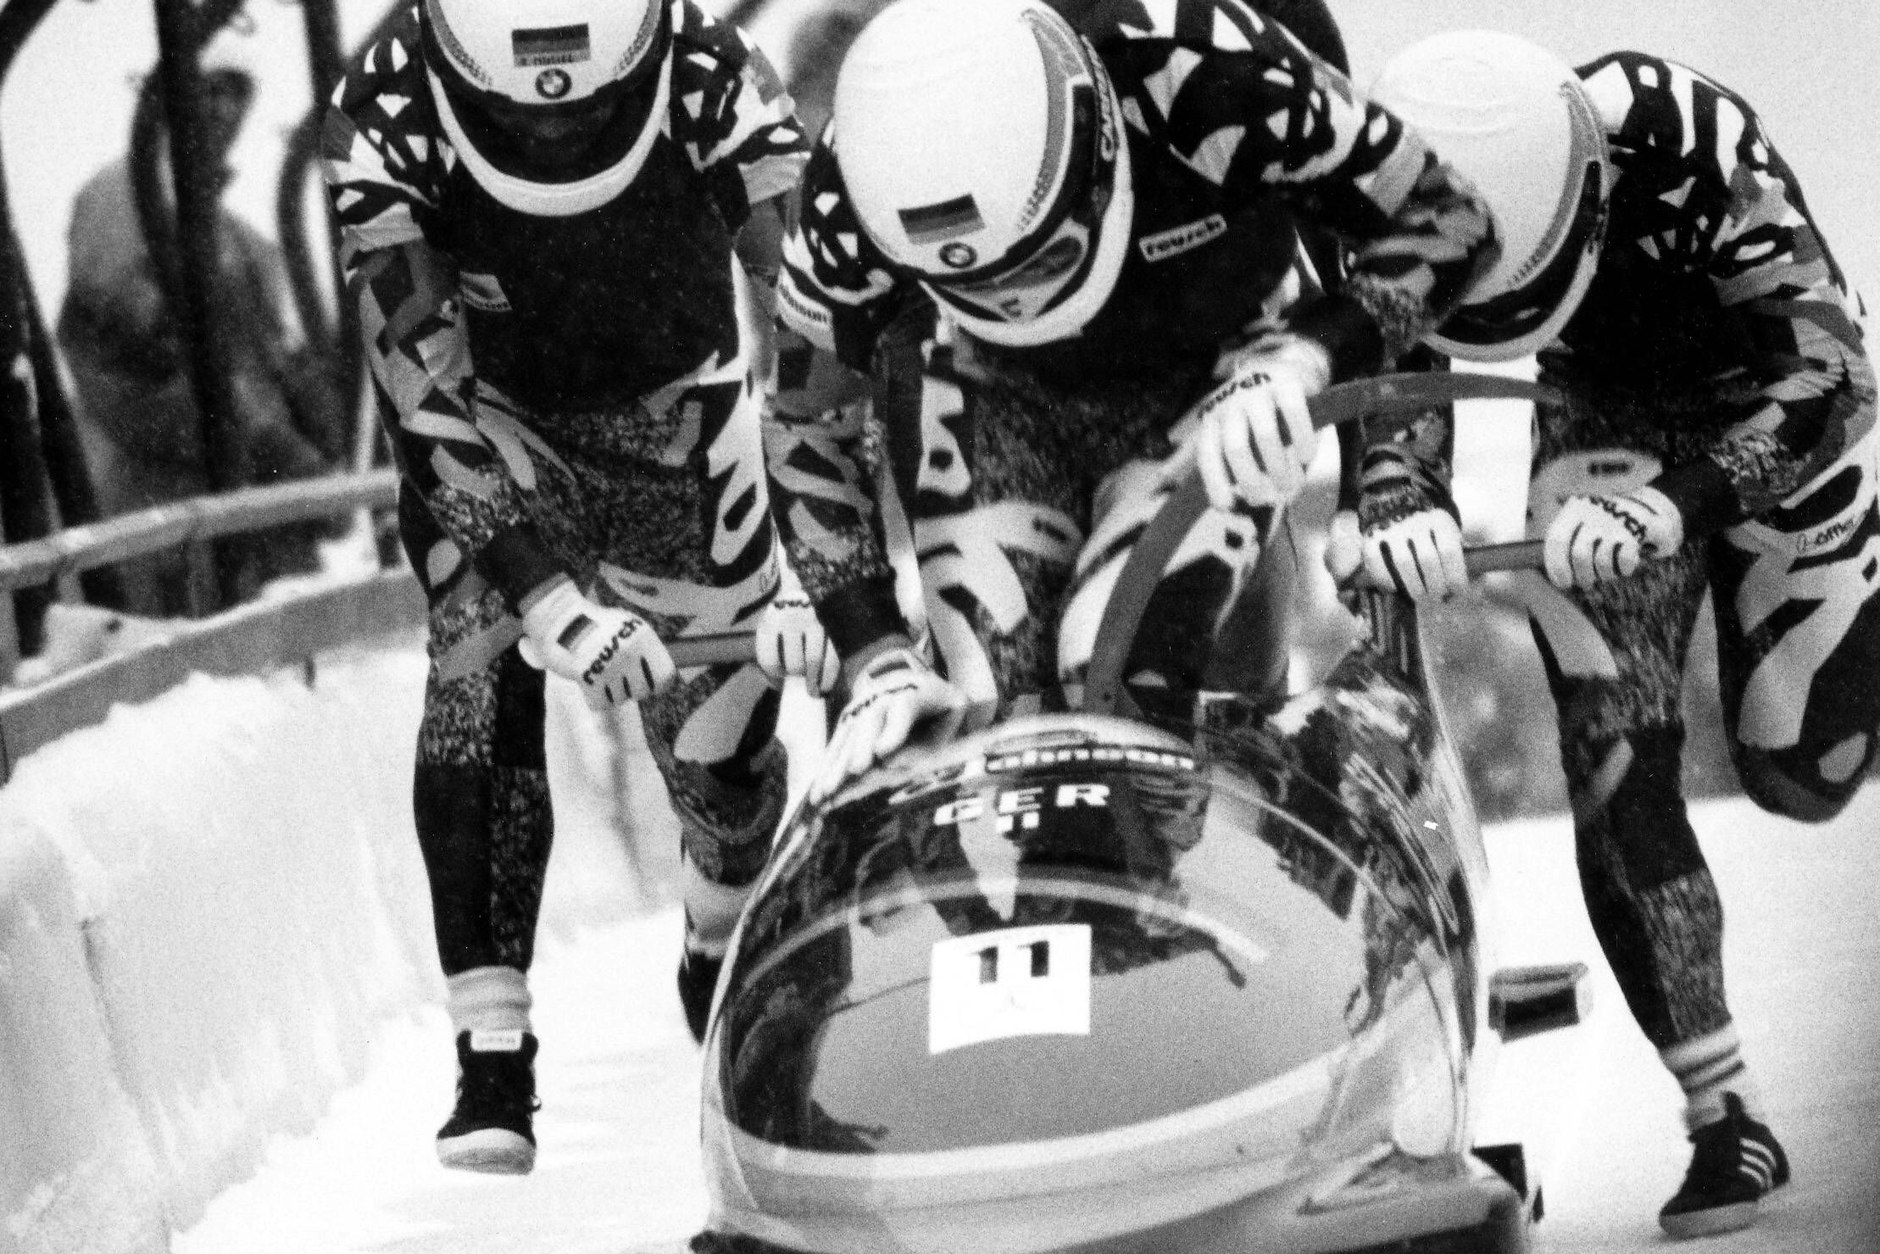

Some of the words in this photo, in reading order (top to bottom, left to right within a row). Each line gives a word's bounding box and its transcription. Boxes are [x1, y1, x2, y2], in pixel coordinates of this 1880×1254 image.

[582, 617, 643, 686] reusch
[933, 783, 1111, 827] GER
[966, 939, 1051, 985] 11
